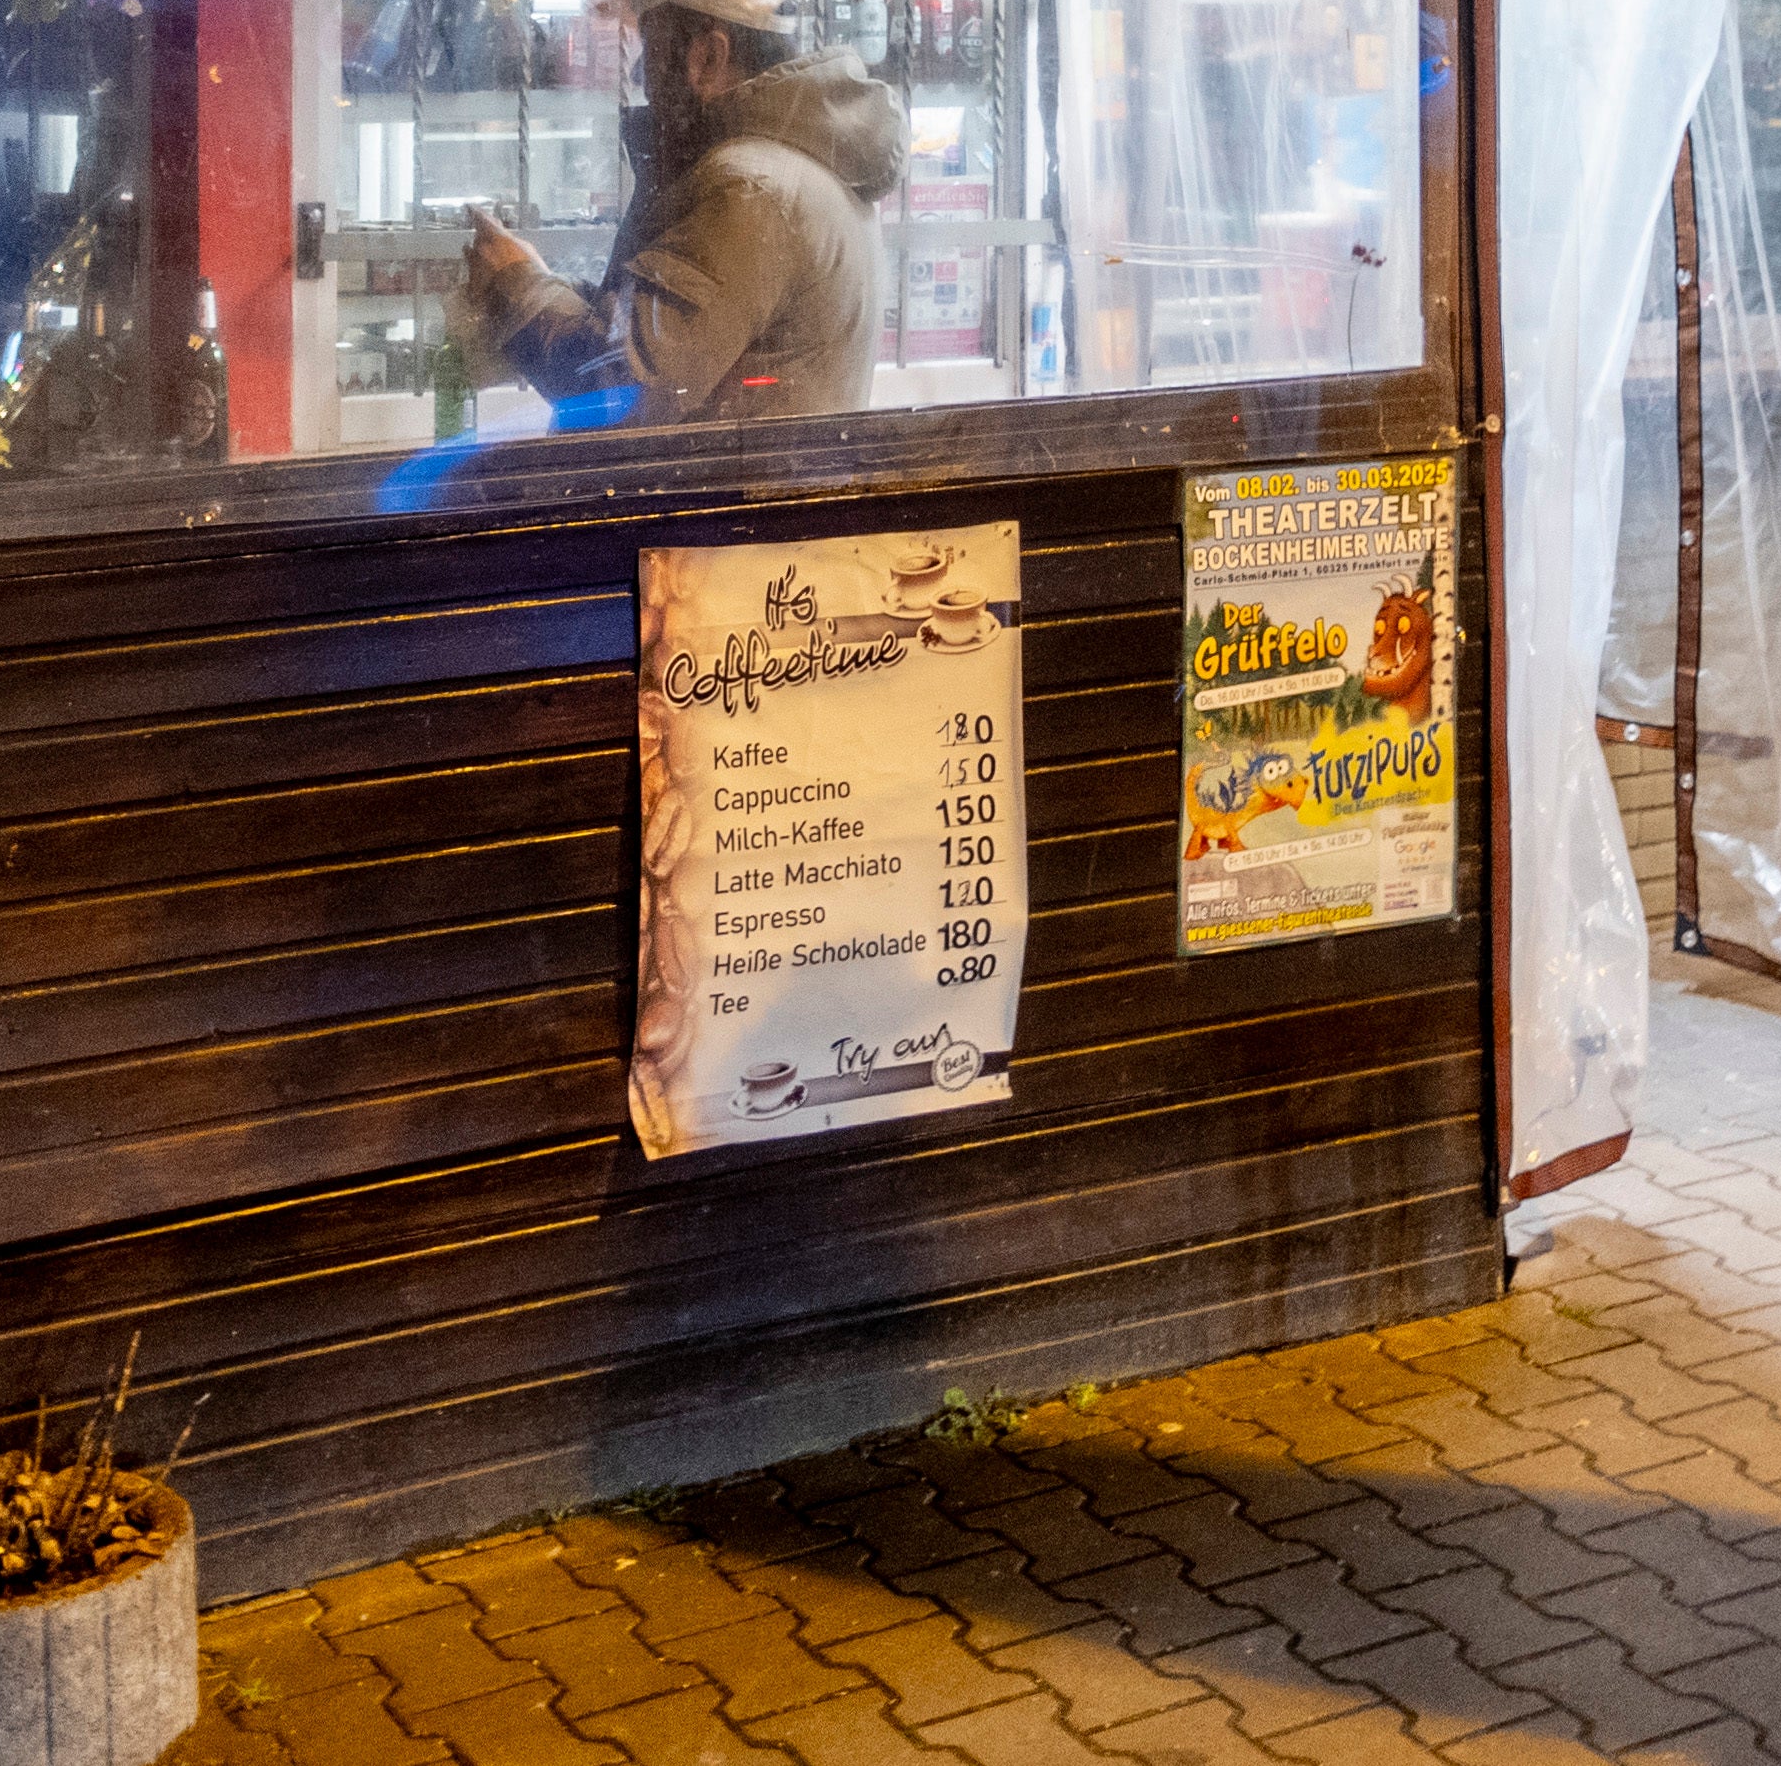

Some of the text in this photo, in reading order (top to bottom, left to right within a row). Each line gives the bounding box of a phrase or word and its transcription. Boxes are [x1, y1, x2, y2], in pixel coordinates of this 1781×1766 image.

[1195, 463, 1449, 503] Vom 08.02. bis 30.03.2025
[1207, 491, 1438, 541] THEATERZELT
[1192, 526, 1450, 573] BOCKENHEIMER WARTE
[1193, 568, 1299, 587] Carlo-Schmid-Platz
[1352, 558, 1402, 572] Frankfurt
[1222, 601, 1264, 629] Der
[663, 617, 908, 714] Coffeetime
[1193, 617, 1349, 681] Grüffelo
[713, 741, 789, 771] Kaffee
[714, 777, 852, 815] Cappuccino
[714, 816, 865, 855] Milch-Kaffee
[714, 868, 775, 895] Latte
[784, 853, 902, 887] Macchiato
[714, 905, 827, 939] Espresso
[712, 917, 992, 978] Heiße Schokolade 180
[709, 992, 750, 1016] Tee
[830, 1036, 880, 1083] Try
[941, 1049, 972, 1074] Best
